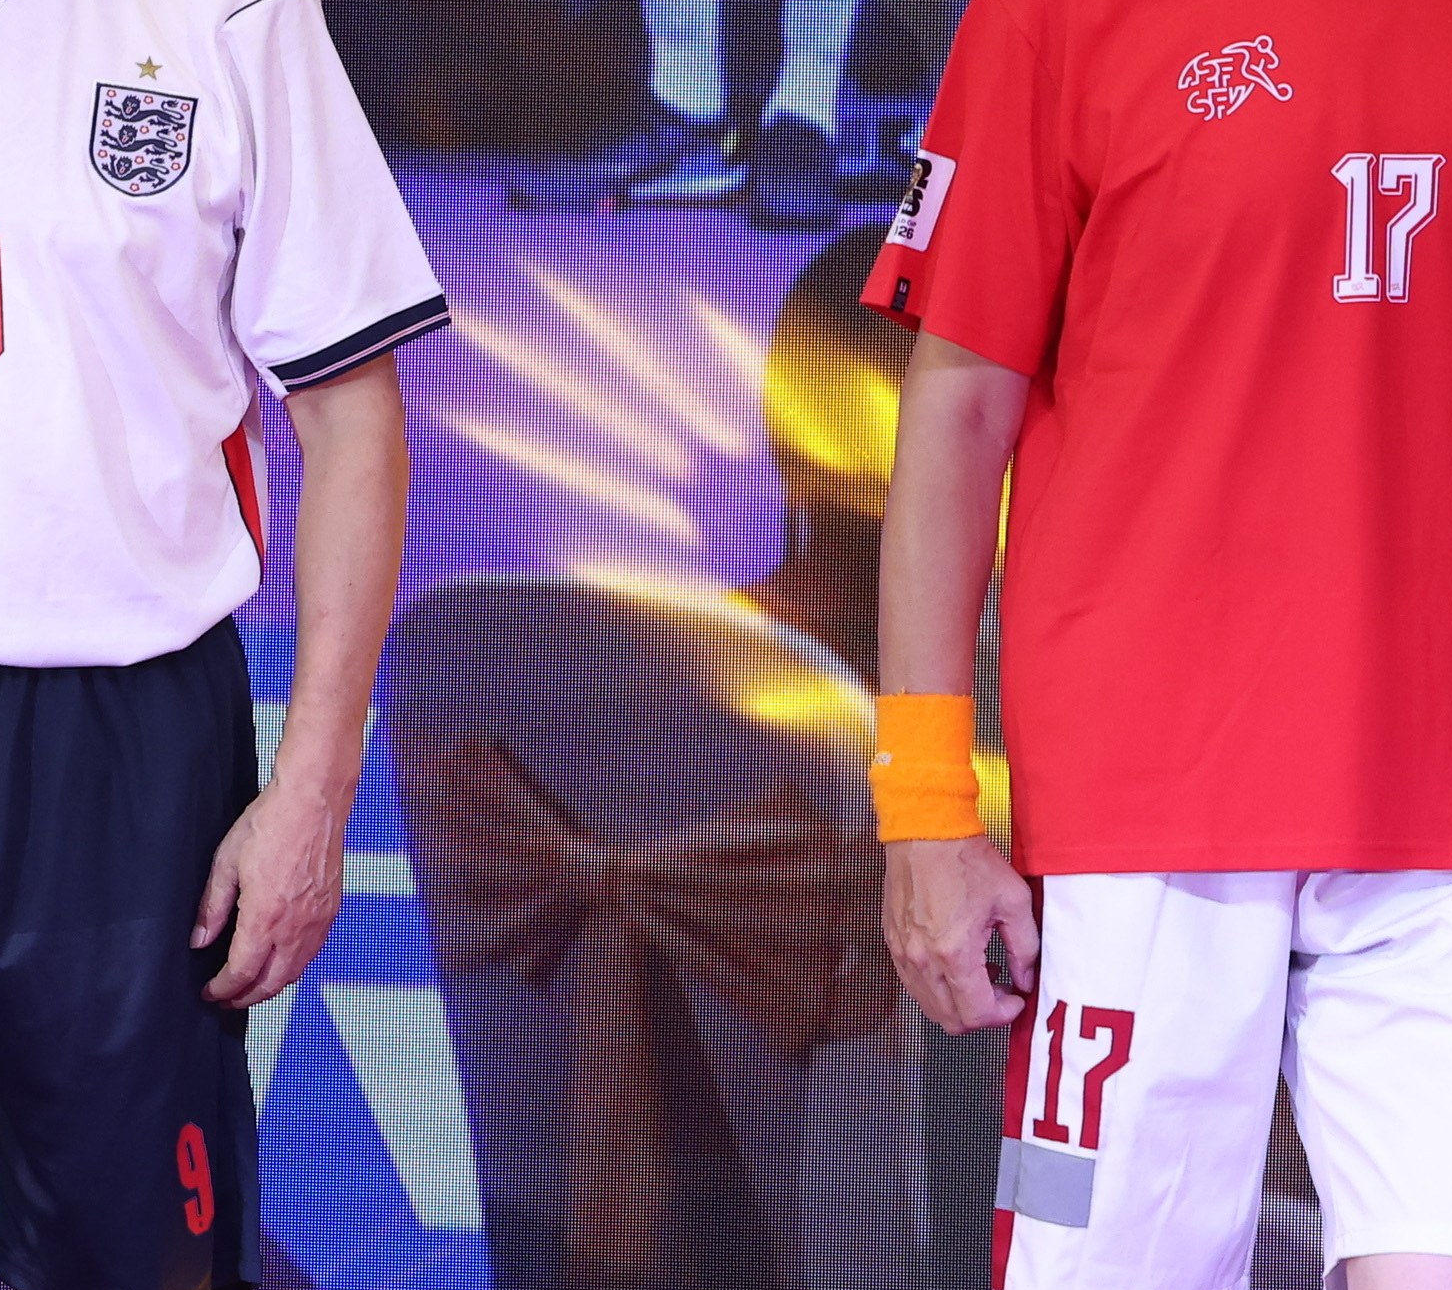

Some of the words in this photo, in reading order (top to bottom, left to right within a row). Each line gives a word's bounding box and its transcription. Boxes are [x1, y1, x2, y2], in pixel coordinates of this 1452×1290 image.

[1330, 152, 1446, 304] 17
[1031, 999, 1135, 1150] 17
[176, 1122, 214, 1236] 9
